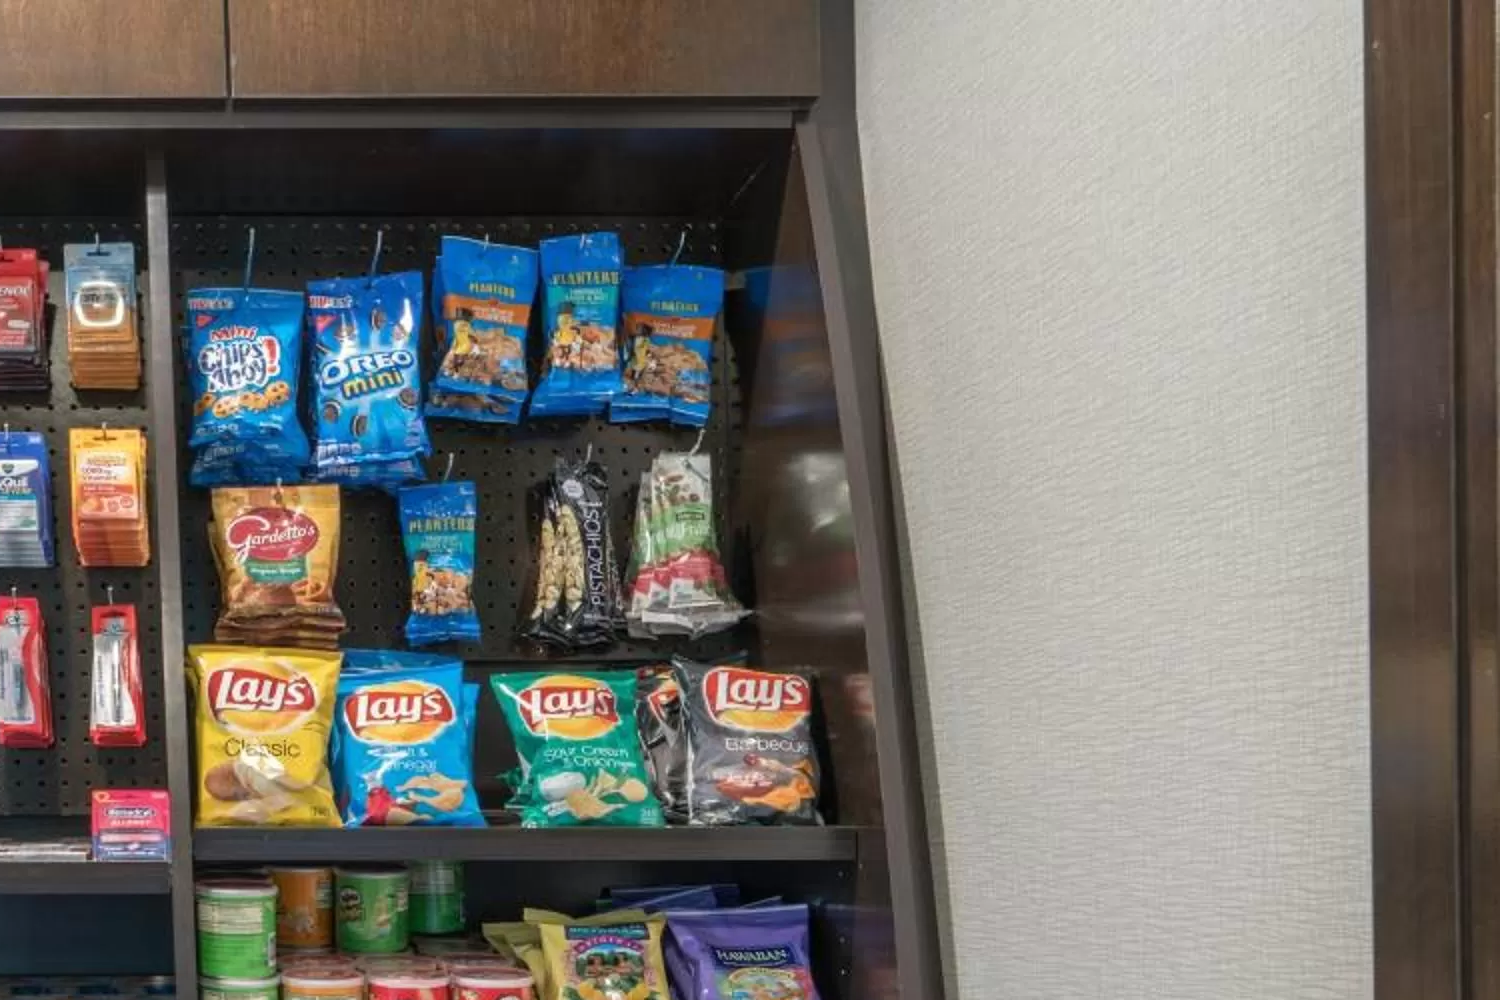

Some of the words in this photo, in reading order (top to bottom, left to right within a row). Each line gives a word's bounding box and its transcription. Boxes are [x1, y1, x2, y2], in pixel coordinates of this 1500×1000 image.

[199, 342, 263, 372] Chips
[322, 351, 412, 387] OREO
[342, 369, 404, 398] mini
[226, 515, 316, 565] Gardetto's
[216, 671, 307, 712] Lay's
[357, 689, 444, 728] Lay's
[528, 689, 614, 723] Lay's
[717, 671, 805, 711] Lay's
[224, 738, 300, 757] Classic
[581, 745, 629, 758] Cream
